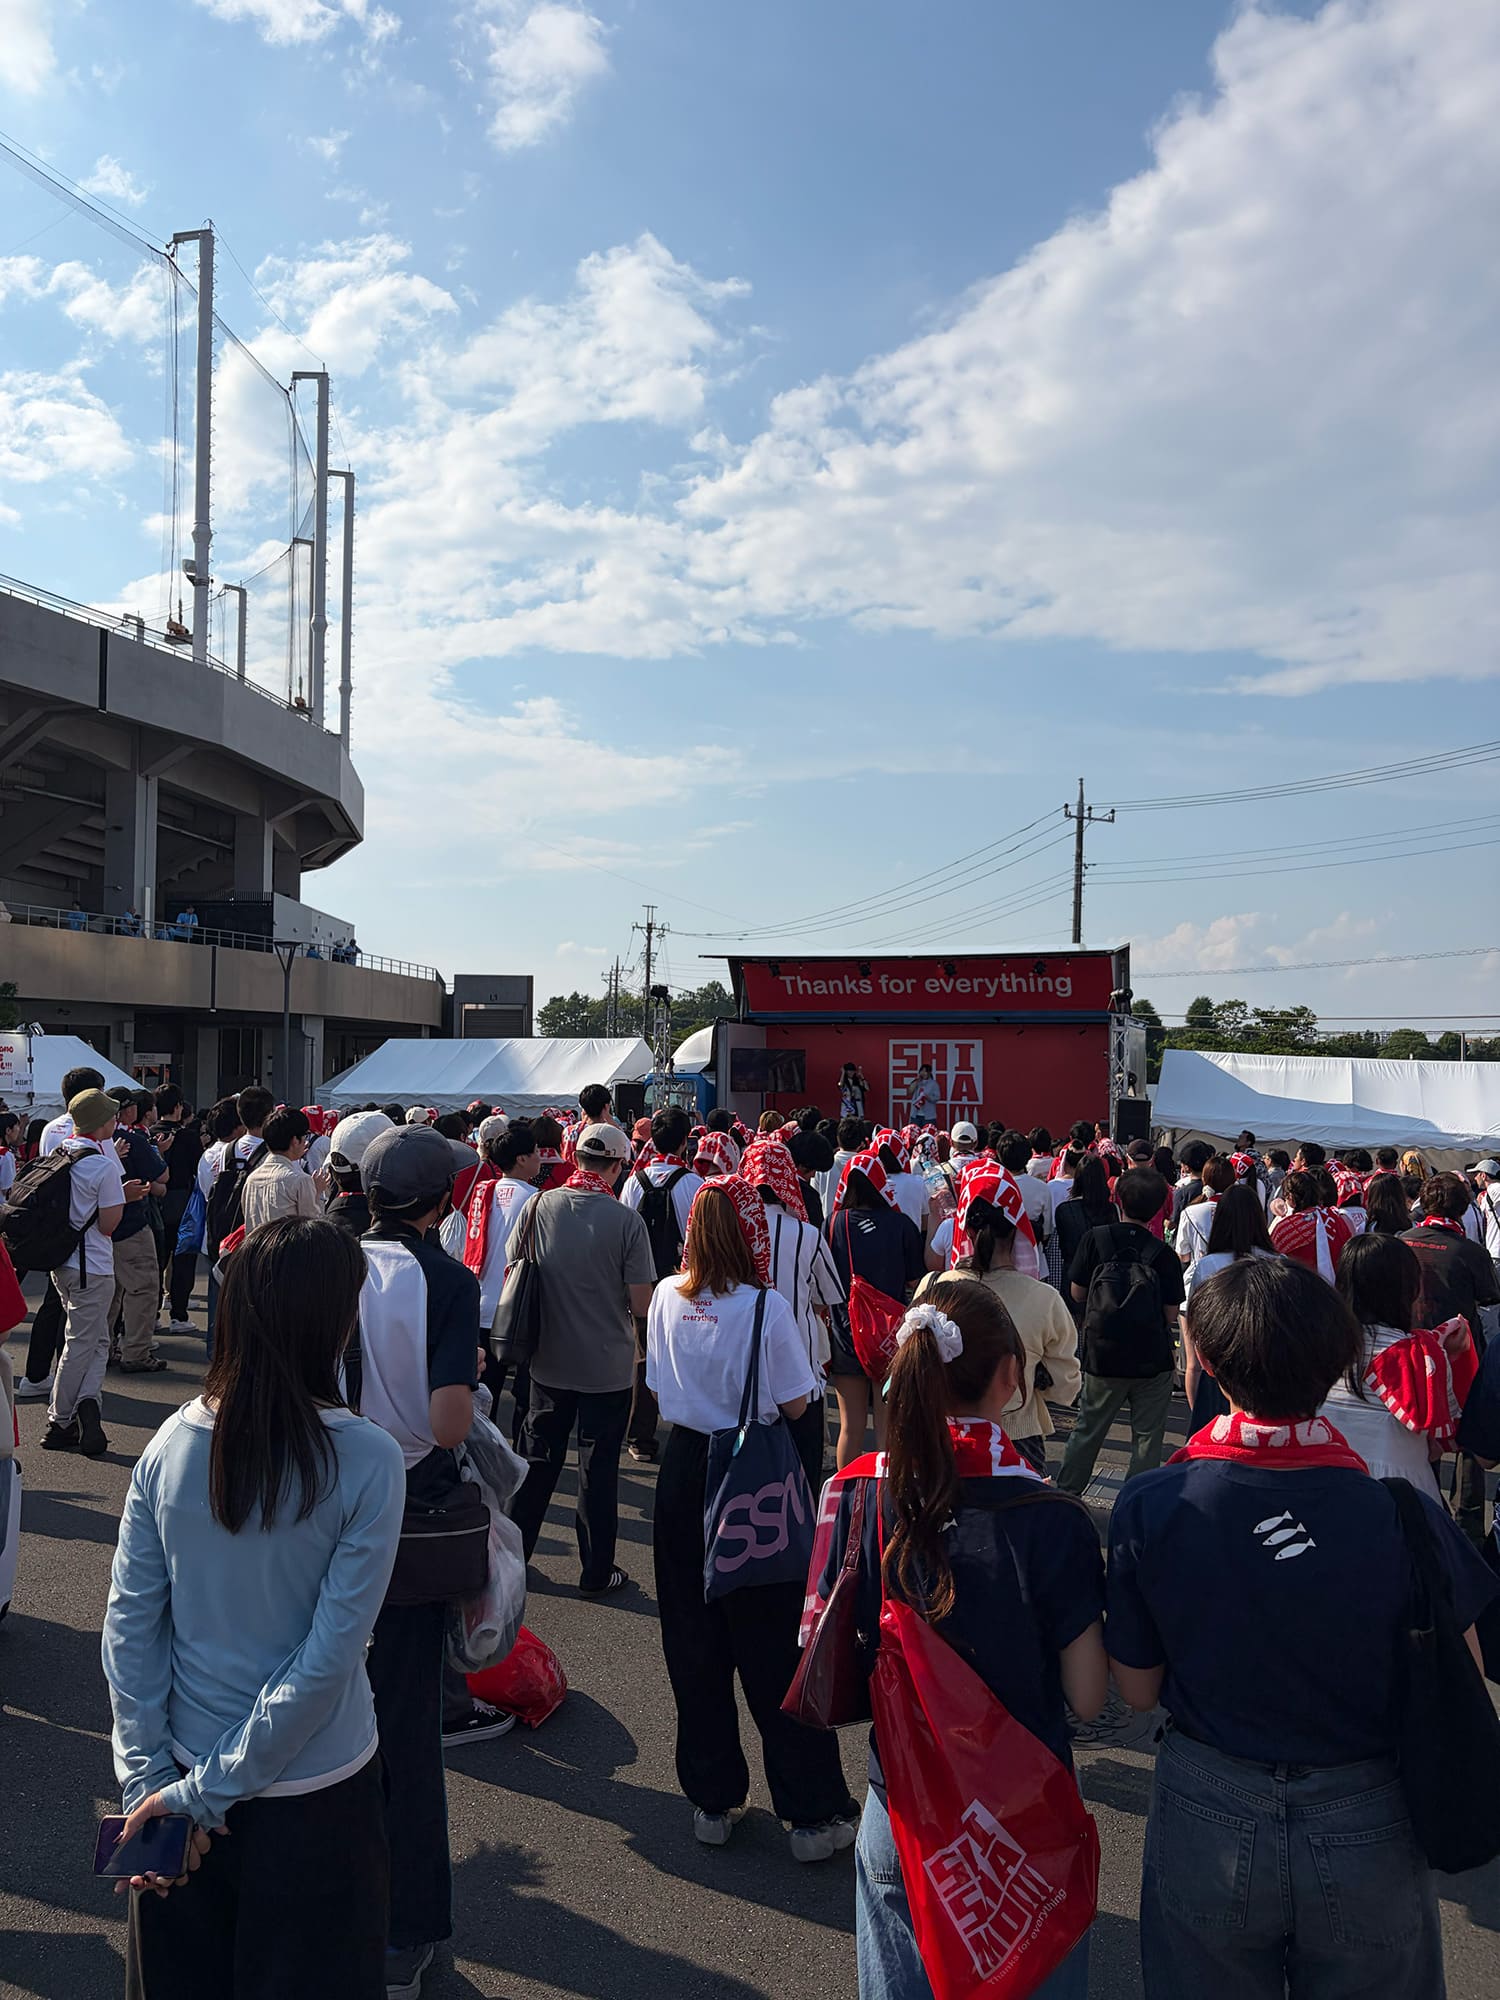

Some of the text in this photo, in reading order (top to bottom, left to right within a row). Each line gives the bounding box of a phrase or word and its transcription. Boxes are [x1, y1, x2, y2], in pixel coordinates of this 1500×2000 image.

[779, 972, 1073, 998] Thanks for everything
[682, 1313, 719, 1324] everything
[988, 1887, 1067, 1985] Thanks for everything
